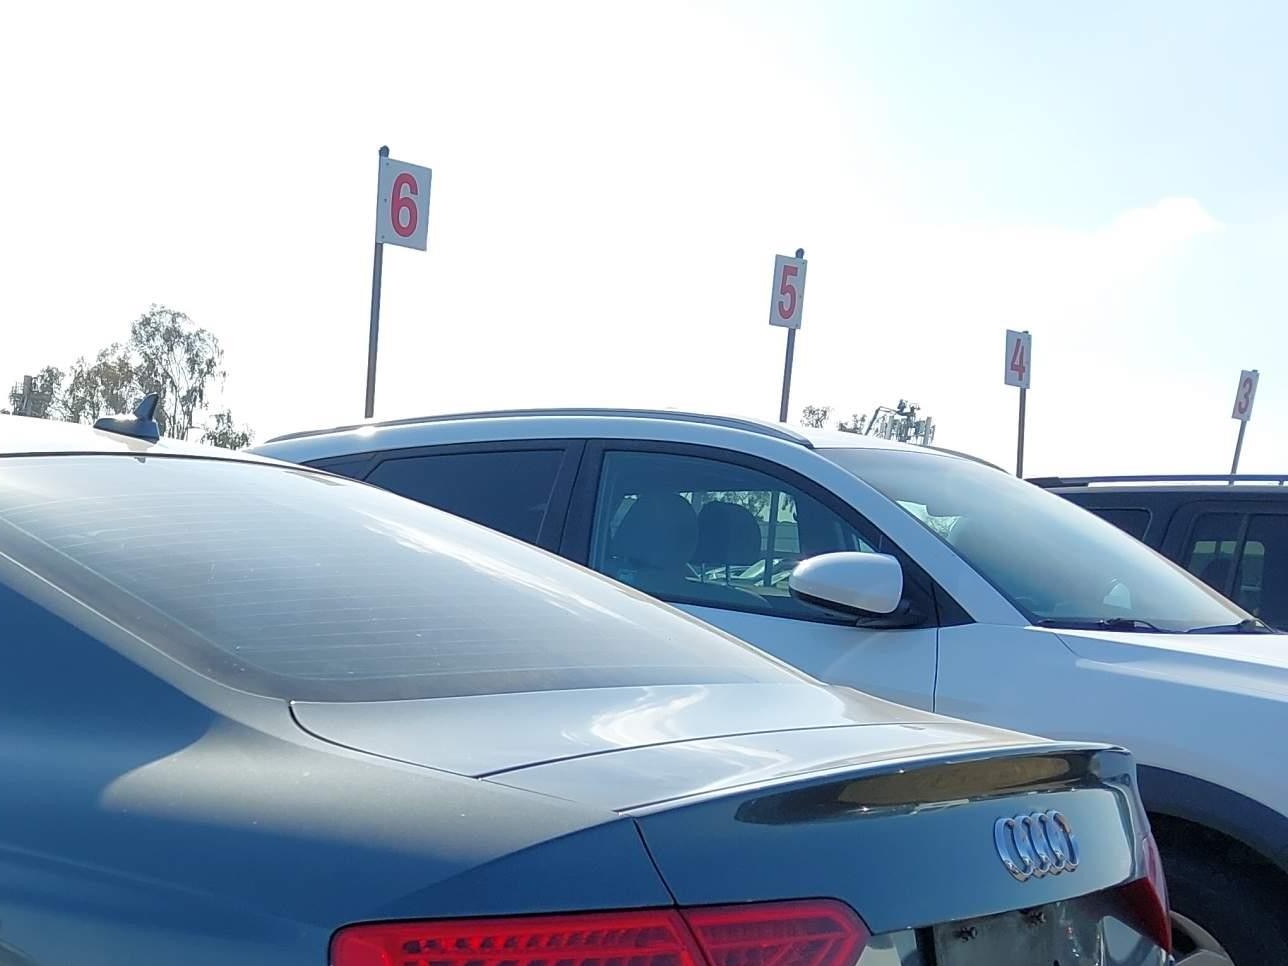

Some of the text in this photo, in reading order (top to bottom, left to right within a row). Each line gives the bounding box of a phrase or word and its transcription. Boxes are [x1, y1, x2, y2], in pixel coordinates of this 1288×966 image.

[391, 173, 418, 237] 6
[778, 265, 798, 319] 5
[1011, 338, 1025, 381] 4
[1238, 377, 1252, 414] 3
